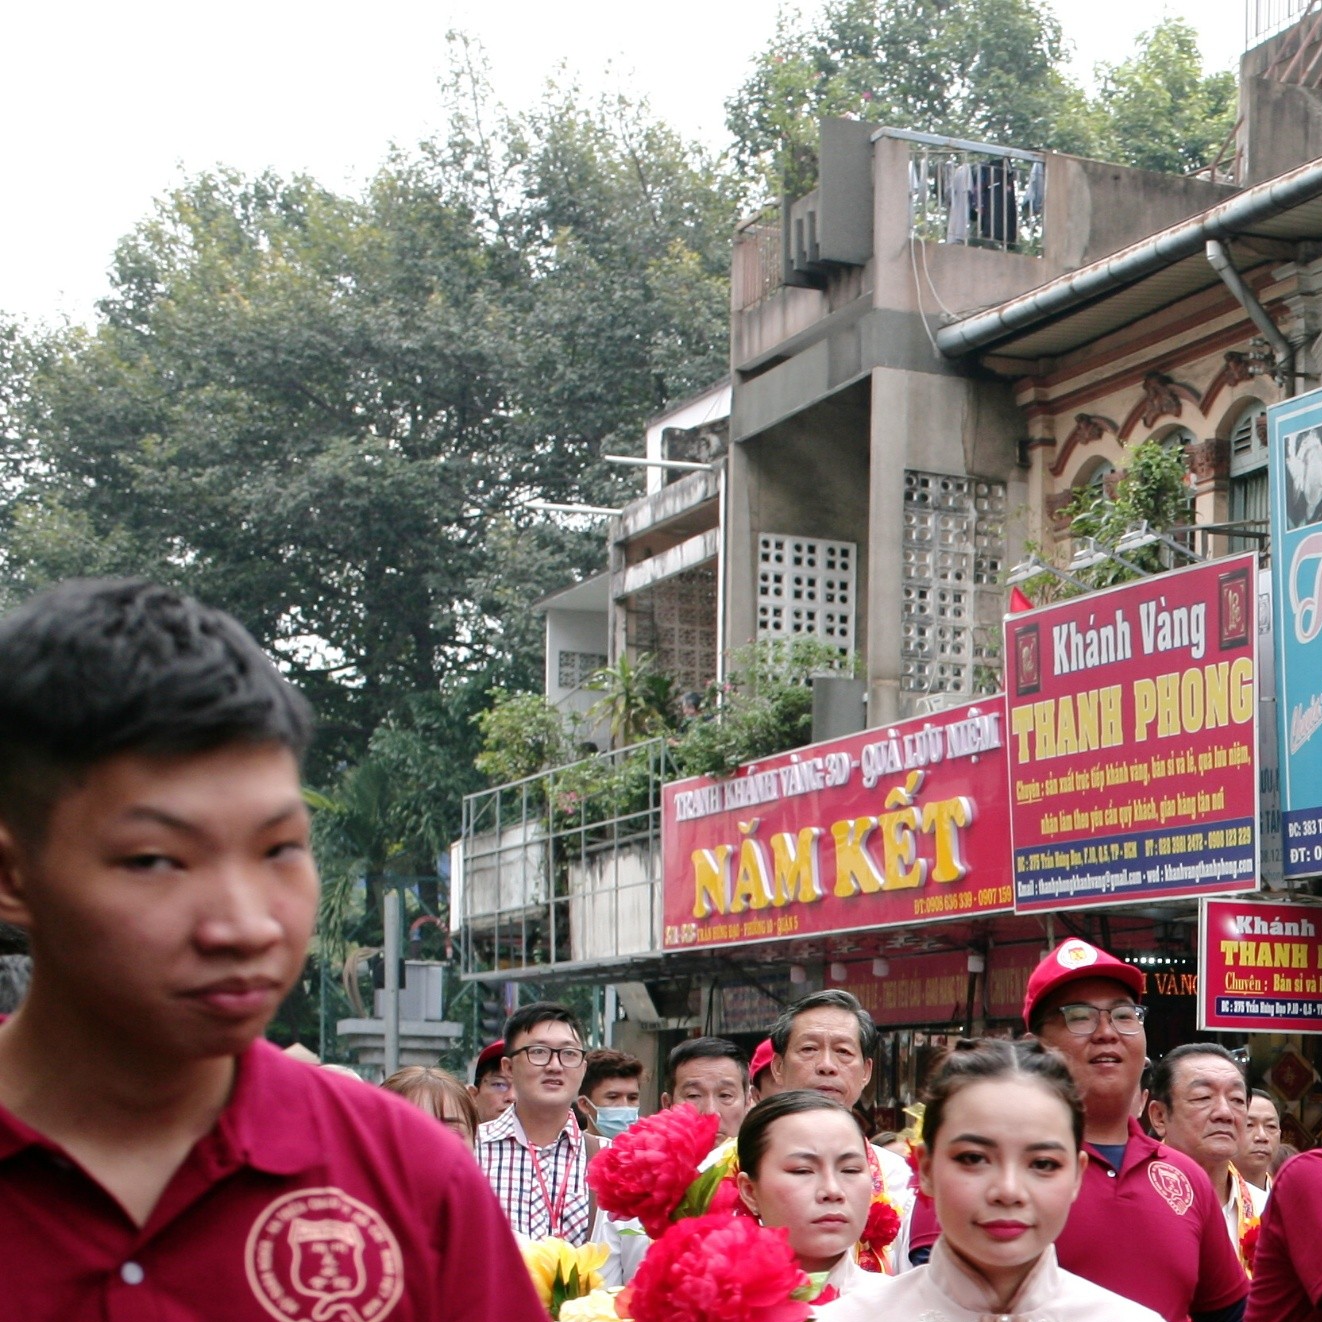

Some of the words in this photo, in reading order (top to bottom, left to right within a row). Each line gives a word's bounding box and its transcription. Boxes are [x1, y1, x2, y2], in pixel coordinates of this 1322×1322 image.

[1052, 609, 1132, 676] Khánh
[1138, 596, 1206, 659] Vàng
[1011, 684, 1124, 764] THANH
[1133, 656, 1254, 742] PHONG
[674, 783, 723, 822] TRANH
[724, 765, 781, 811] KHÁNH
[781, 754, 825, 798] VÀNG
[825, 752, 850, 787] 3D
[946, 706, 1002, 763] NIỆM
[1105, 761, 1129, 786] khánh
[1303, 820, 1317, 836] 383
[691, 817, 826, 919] NĂM
[831, 770, 975, 897] KẾT
[1290, 847, 1311, 864] ĐT:
[1235, 915, 1315, 937] Khánh
[1220, 940, 1308, 969] THANH
[1273, 973, 1292, 993] Bán
[1294, 973, 1304, 993] sỉ
[1305, 974, 1317, 993] và
